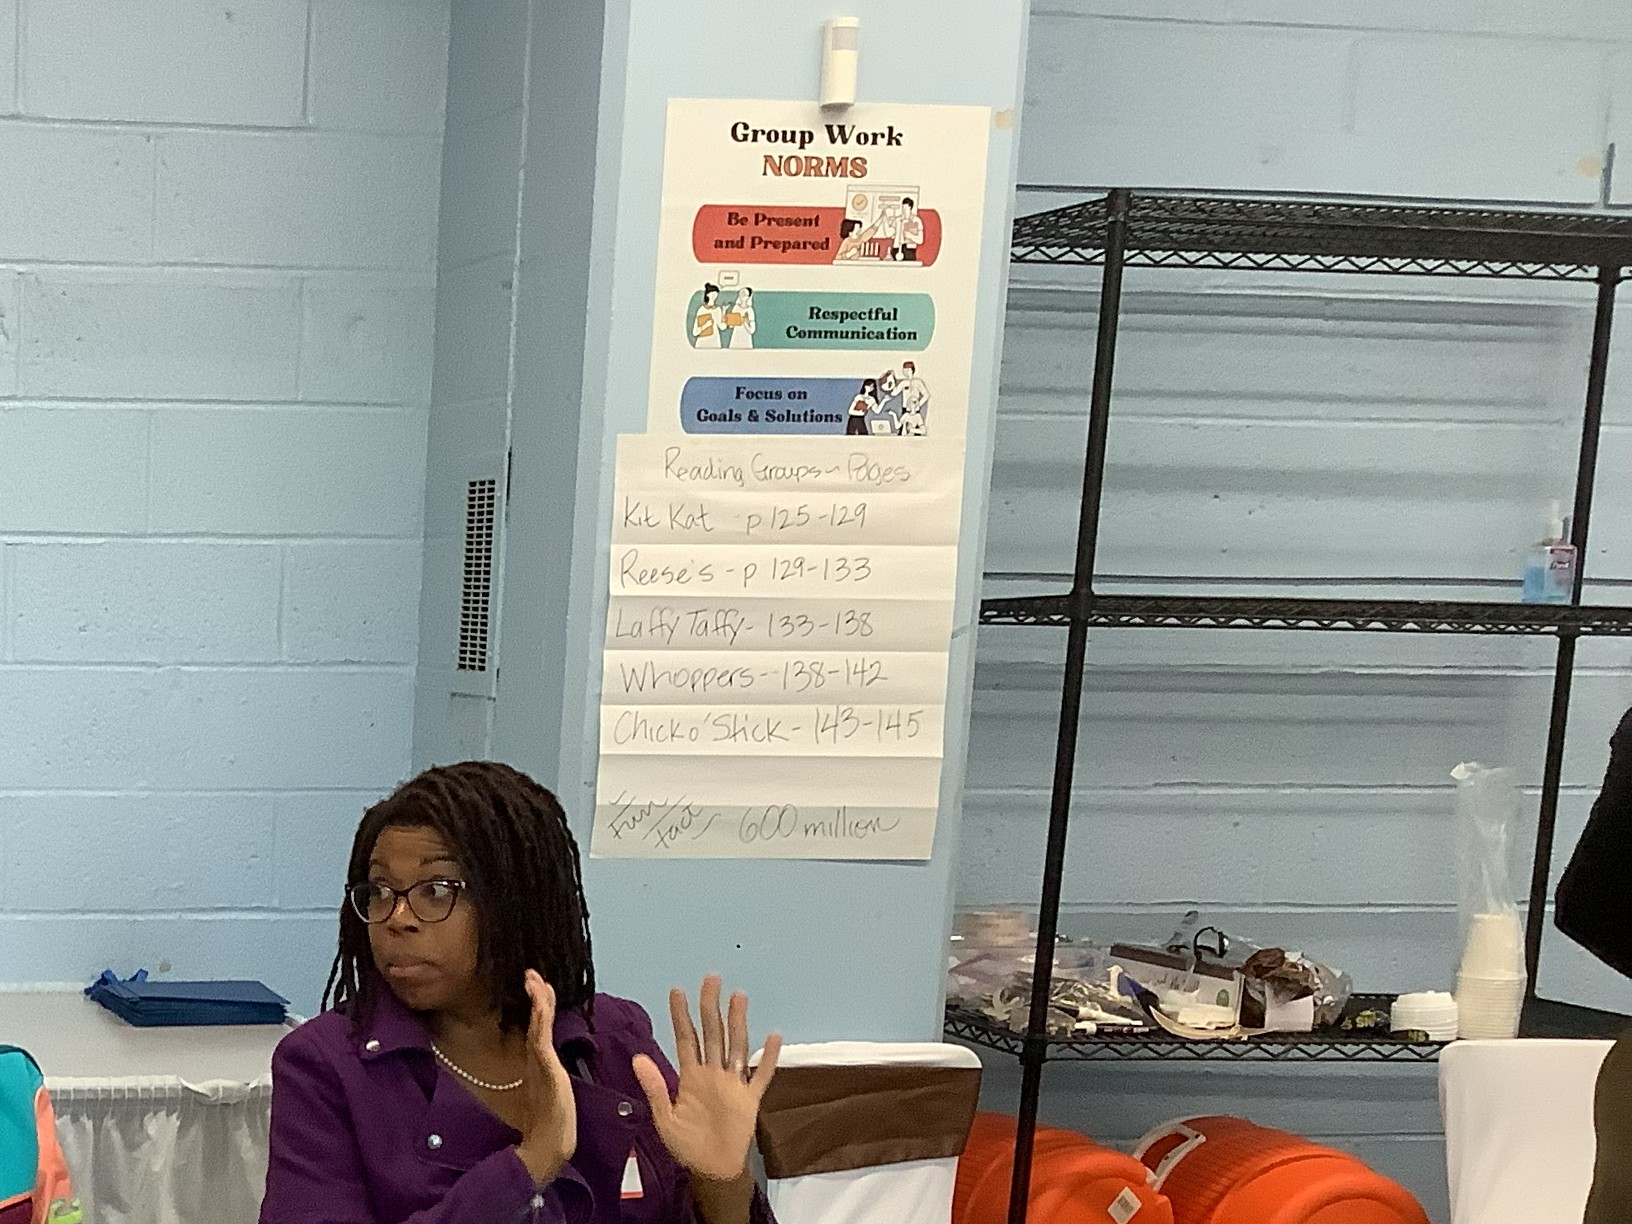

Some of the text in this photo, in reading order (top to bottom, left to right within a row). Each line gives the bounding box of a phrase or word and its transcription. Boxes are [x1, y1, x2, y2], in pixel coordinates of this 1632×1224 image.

[730, 121, 904, 149] Group Work
[762, 154, 868, 179] NORMS
[726, 211, 821, 228] Be Present
[713, 236, 831, 253] and Prepared
[808, 306, 899, 324] Respectful
[785, 325, 918, 342] Communication
[734, 386, 808, 401] Focus on
[696, 408, 843, 424] Goals & Solutions
[664, 446, 744, 487] Reading
[847, 453, 912, 486] Pages
[623, 496, 660, 529] Kit
[668, 503, 714, 532] Kat
[770, 503, 868, 530] 125-129
[620, 549, 714, 588] Reese's
[771, 556, 872, 582] 129-133
[615, 606, 680, 645] Laffy
[768, 609, 874, 638] 133-138
[783, 657, 889, 693] 138-142
[815, 705, 924, 745] 143-145
[739, 803, 799, 844] 600
[804, 805, 900, 839] million
